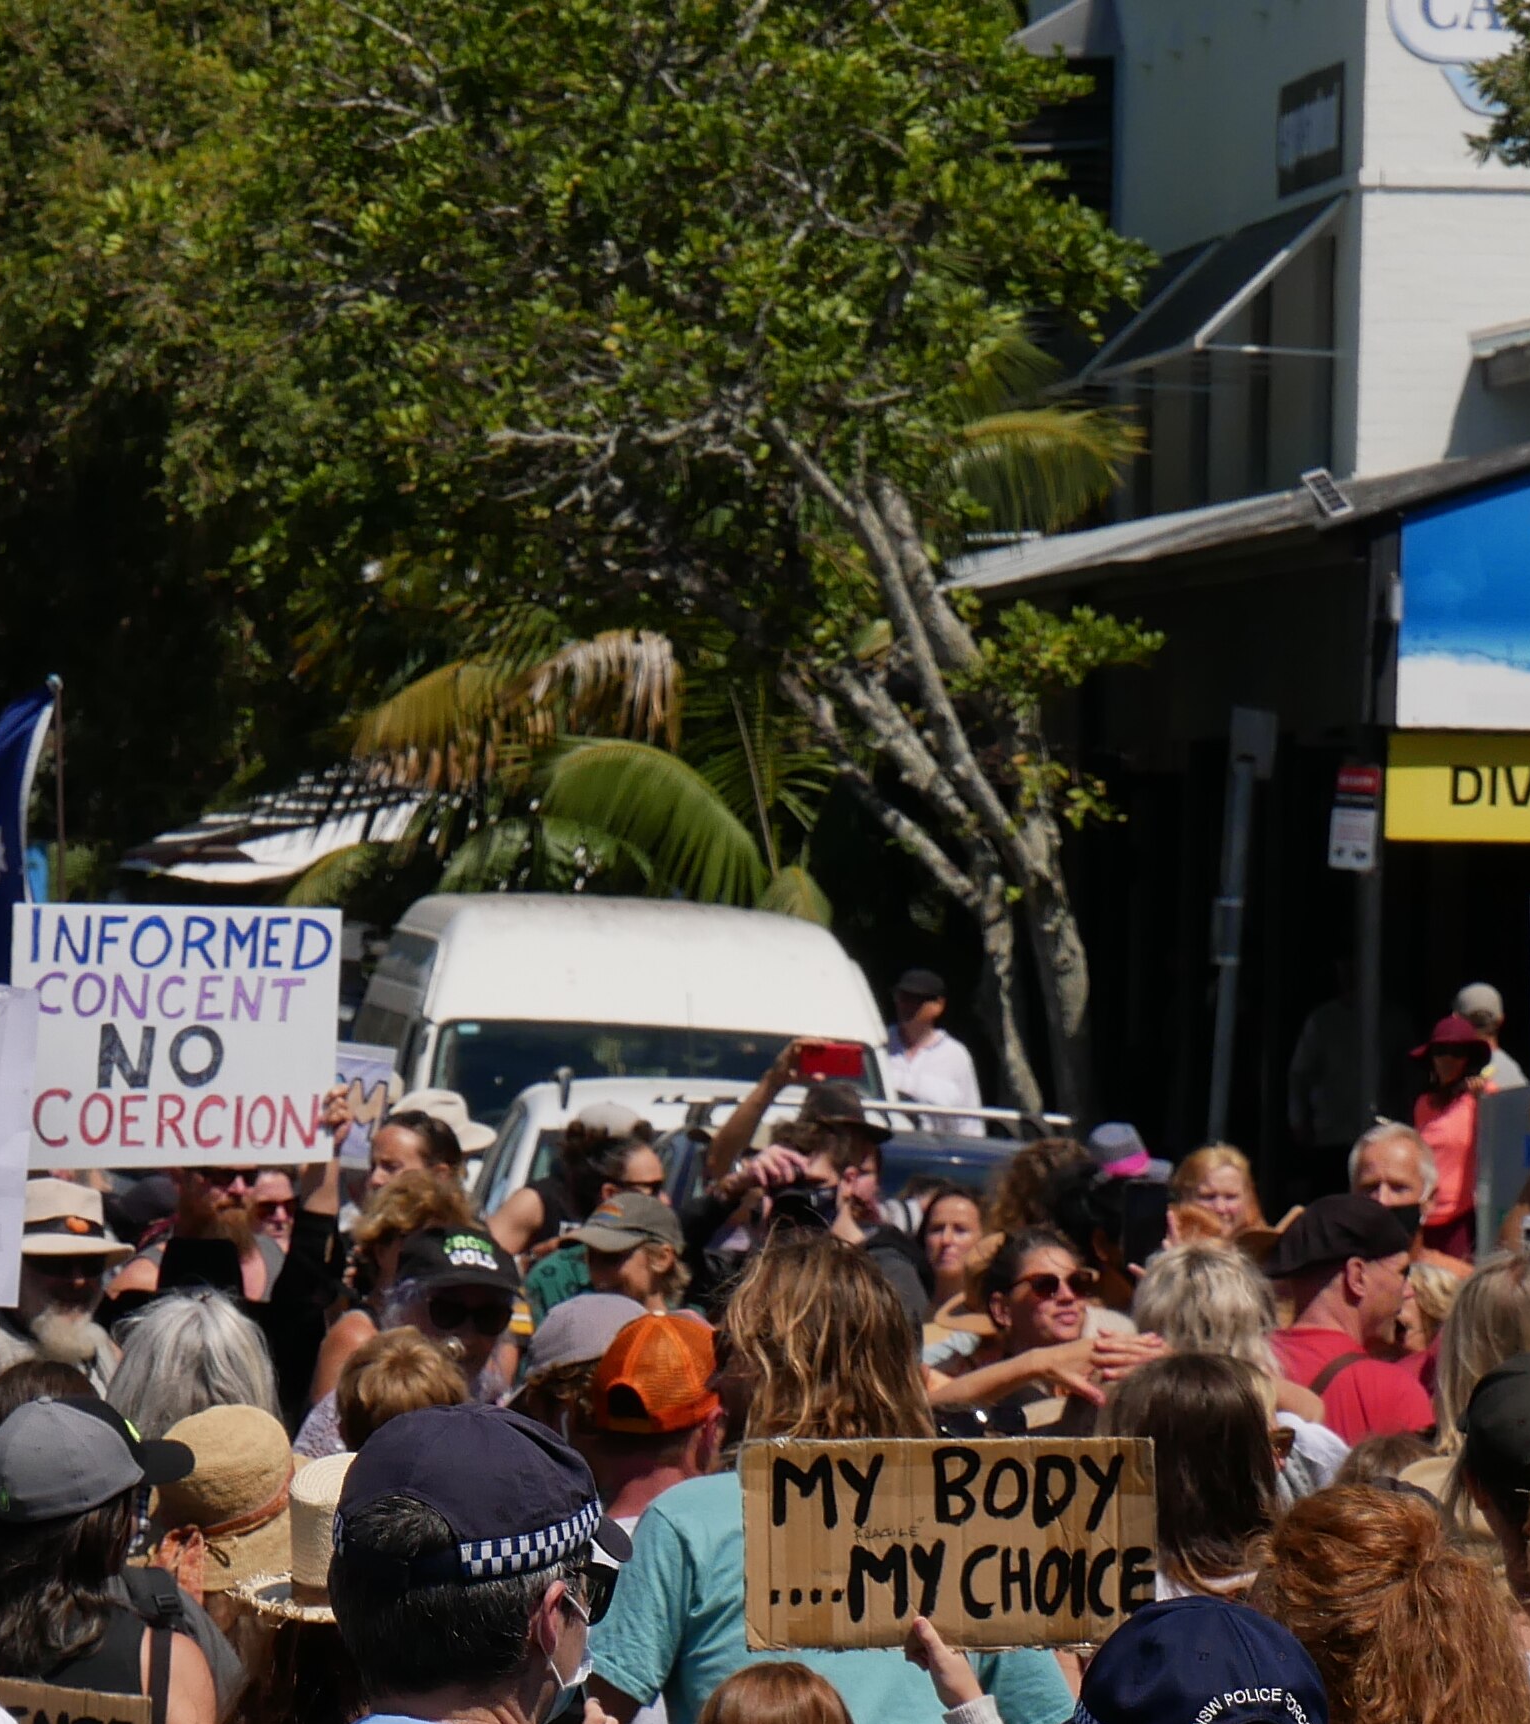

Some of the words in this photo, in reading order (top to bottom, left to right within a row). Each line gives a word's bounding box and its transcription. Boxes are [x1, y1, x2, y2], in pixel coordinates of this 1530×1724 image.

[30, 906, 333, 970] INFORMED
[34, 970, 307, 1022] CONCENT
[97, 1021, 224, 1089] NO
[32, 1087, 321, 1149] COERCION
[772, 1452, 884, 1530] MY
[932, 1446, 1125, 1533] BODY
[960, 1543, 1156, 1621] CHOICE
[1223, 1688, 1283, 1707] POLICE
